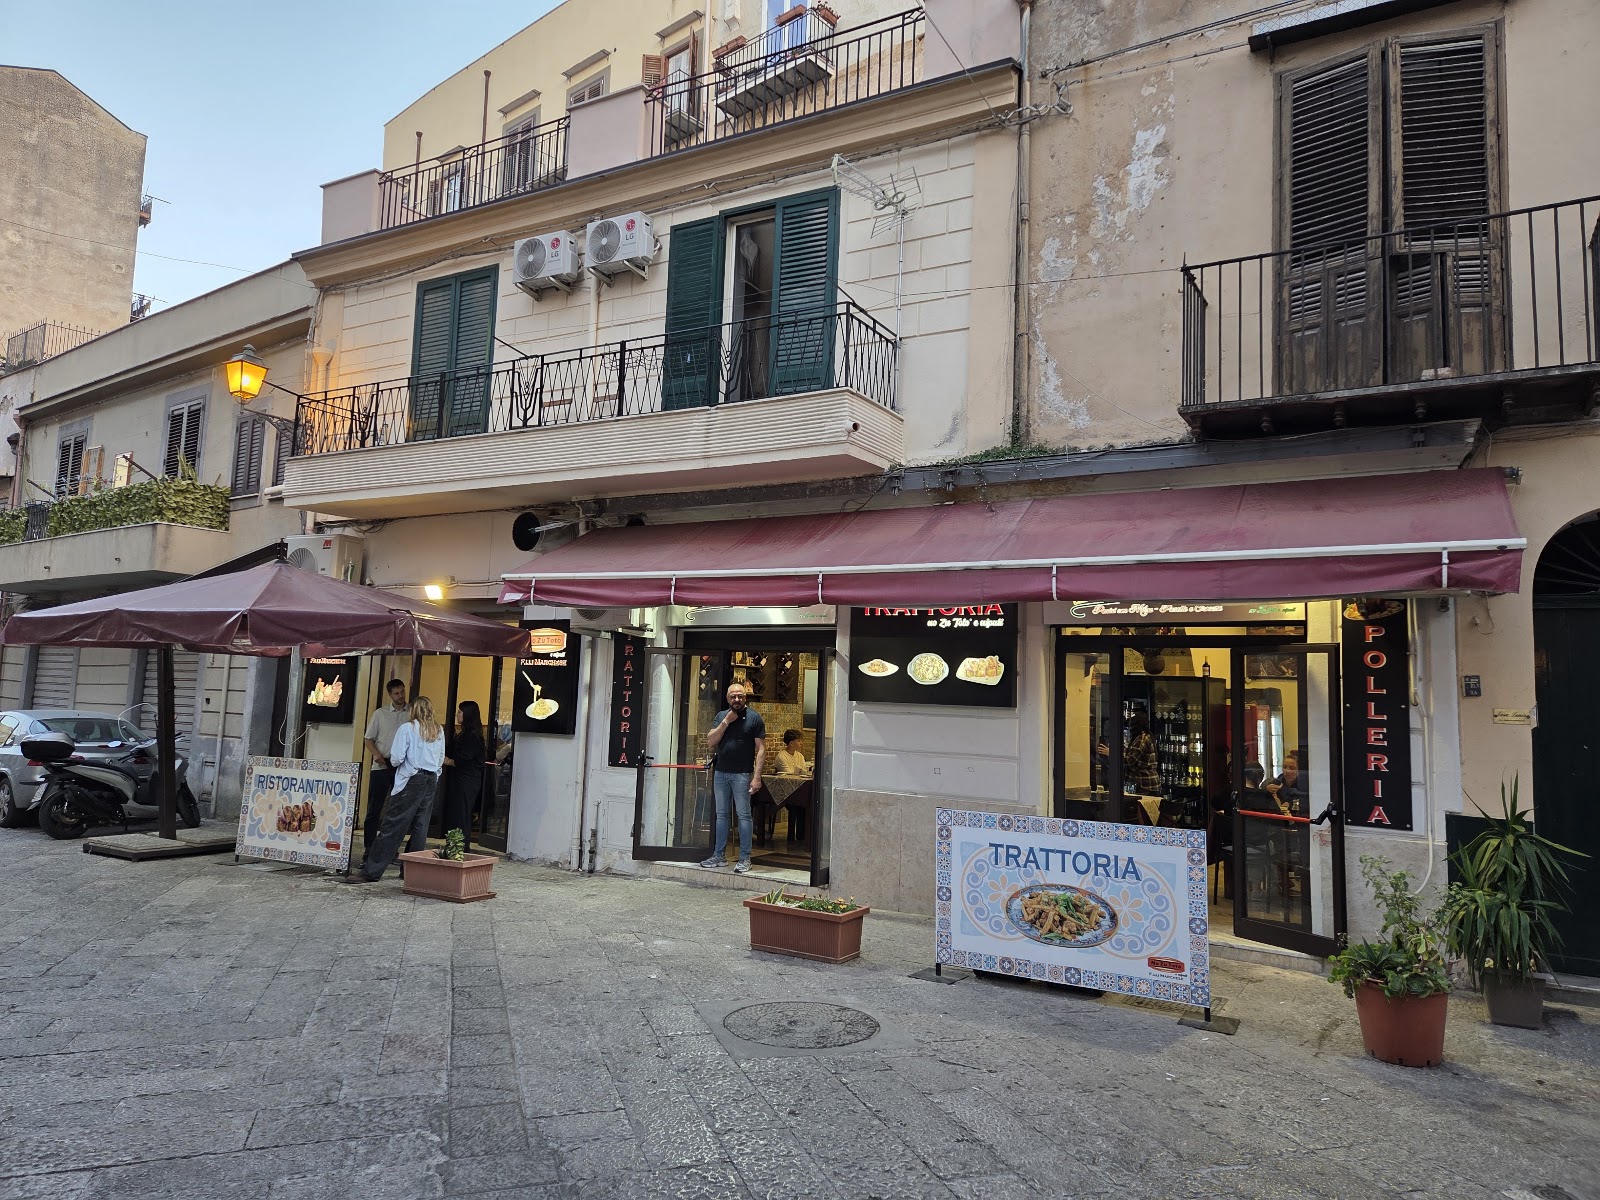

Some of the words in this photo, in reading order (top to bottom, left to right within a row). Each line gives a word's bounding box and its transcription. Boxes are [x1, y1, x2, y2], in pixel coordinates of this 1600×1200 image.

[1363, 625, 1391, 825] POLLERIA
[257, 774, 343, 796] RISTORANTINO
[988, 842, 1142, 881] TRATTORIA
